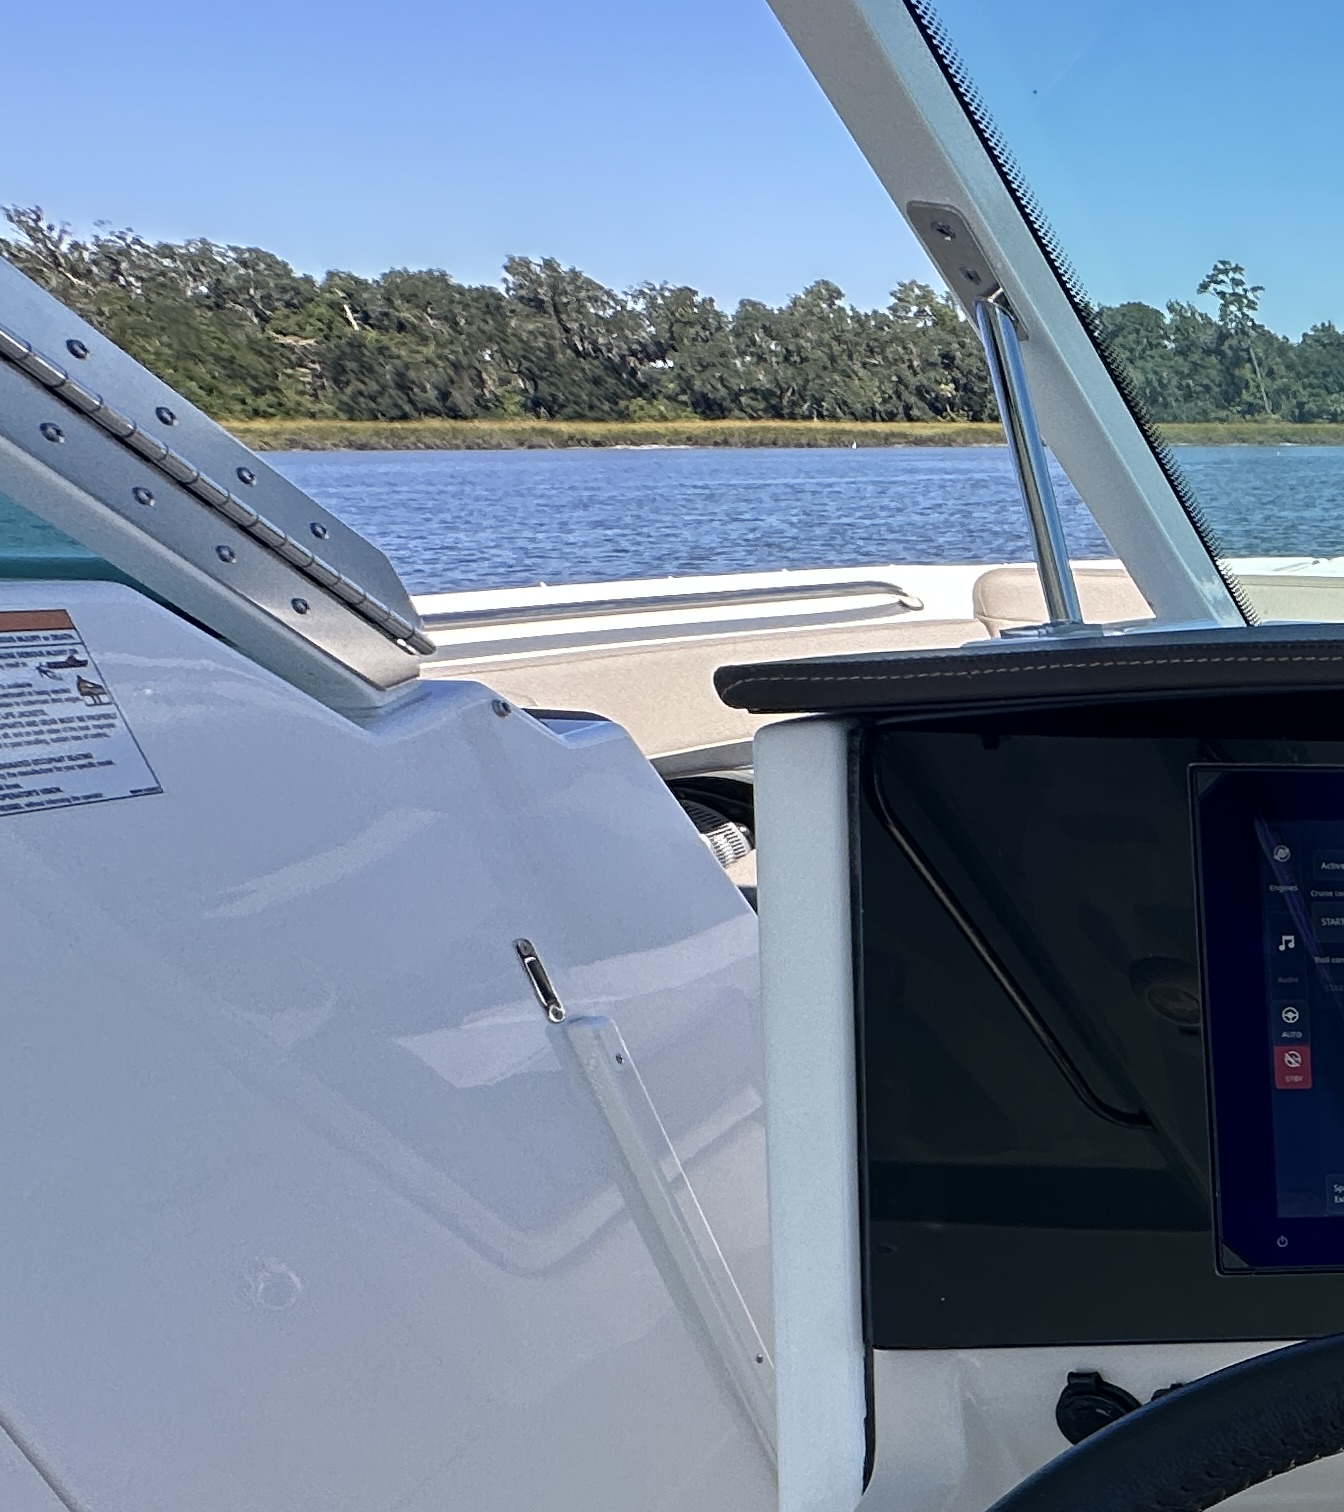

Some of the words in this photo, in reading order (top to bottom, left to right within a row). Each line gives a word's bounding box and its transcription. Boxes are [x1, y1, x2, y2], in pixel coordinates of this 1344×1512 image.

[1321, 861, 1344, 870] Active
[1321, 918, 1344, 926] START
[1282, 1031, 1303, 1039] AUTO
